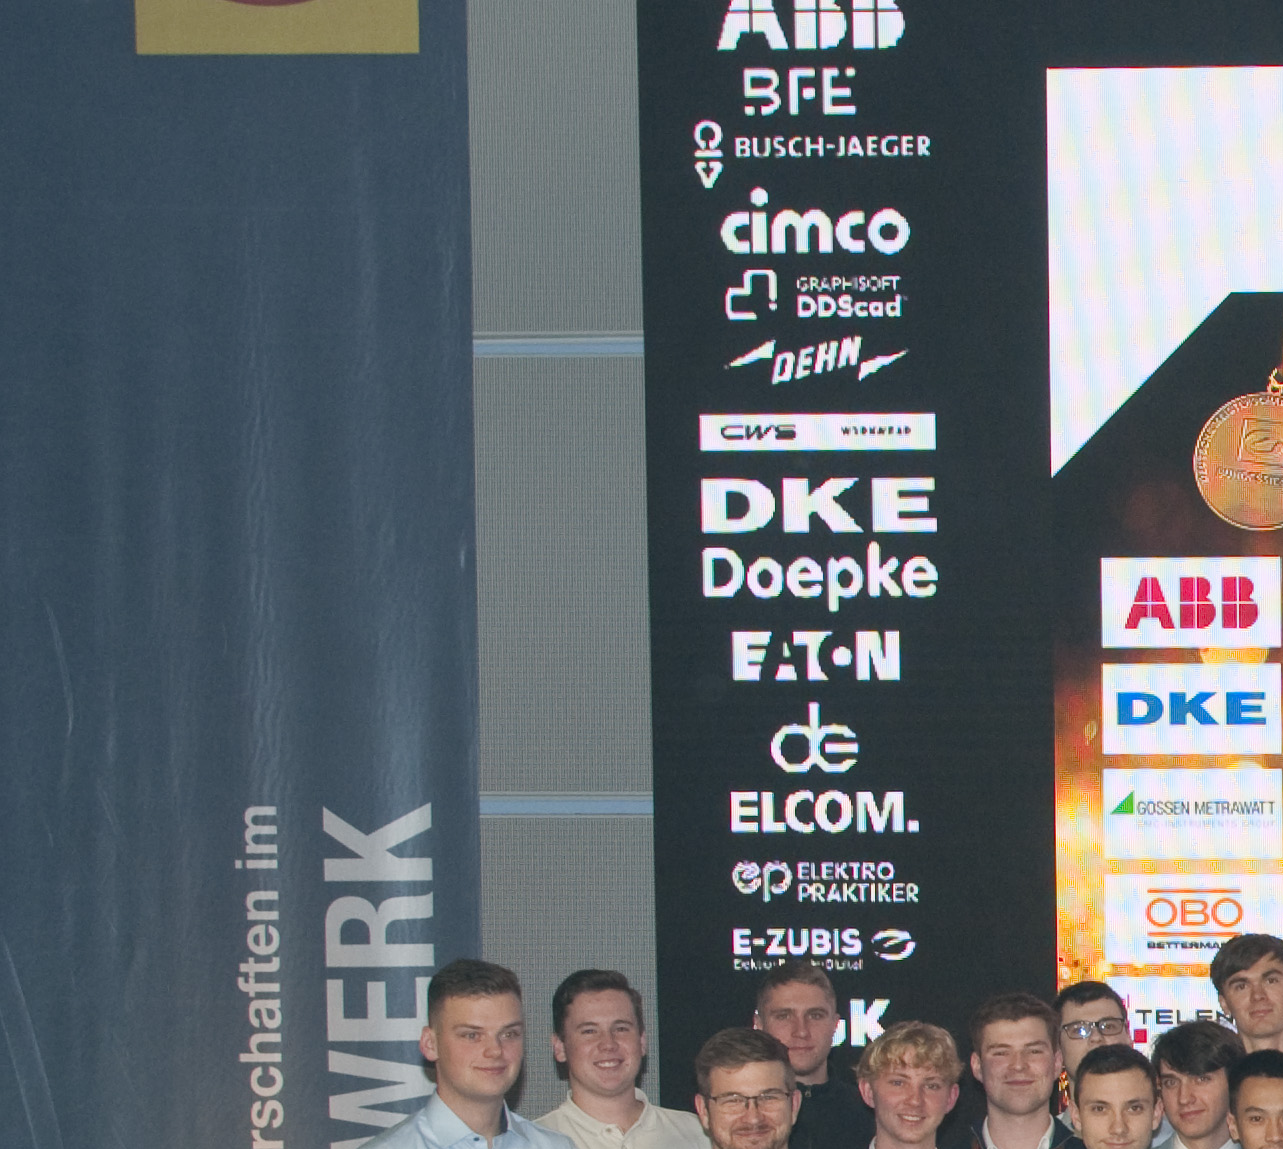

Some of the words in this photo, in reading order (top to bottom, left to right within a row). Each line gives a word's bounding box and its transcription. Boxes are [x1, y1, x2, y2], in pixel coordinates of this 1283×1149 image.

[717, 0, 906, 50] ABB
[743, 67, 856, 116] BFE
[735, 135, 931, 158] BUSCH-JAEGER
[720, 187, 911, 254] cimco
[796, 294, 903, 318] DDScad
[771, 335, 862, 385] DEHN
[701, 477, 938, 533] DKE
[702, 541, 938, 612] Doepke
[1125, 577, 1259, 629] ABB
[1117, 692, 1267, 725] DKE
[1137, 801, 1190, 815] GOSSEN
[1195, 801, 1275, 815] METRAWATT
[235, 804, 278, 868] im
[797, 863, 895, 880] ELEKTRO
[797, 883, 919, 902] PRAKTIKER
[1146, 898, 1243, 927] OBO
[732, 928, 862, 956] E-ZUBIS
[1147, 941, 1224, 949] BETTERMA
